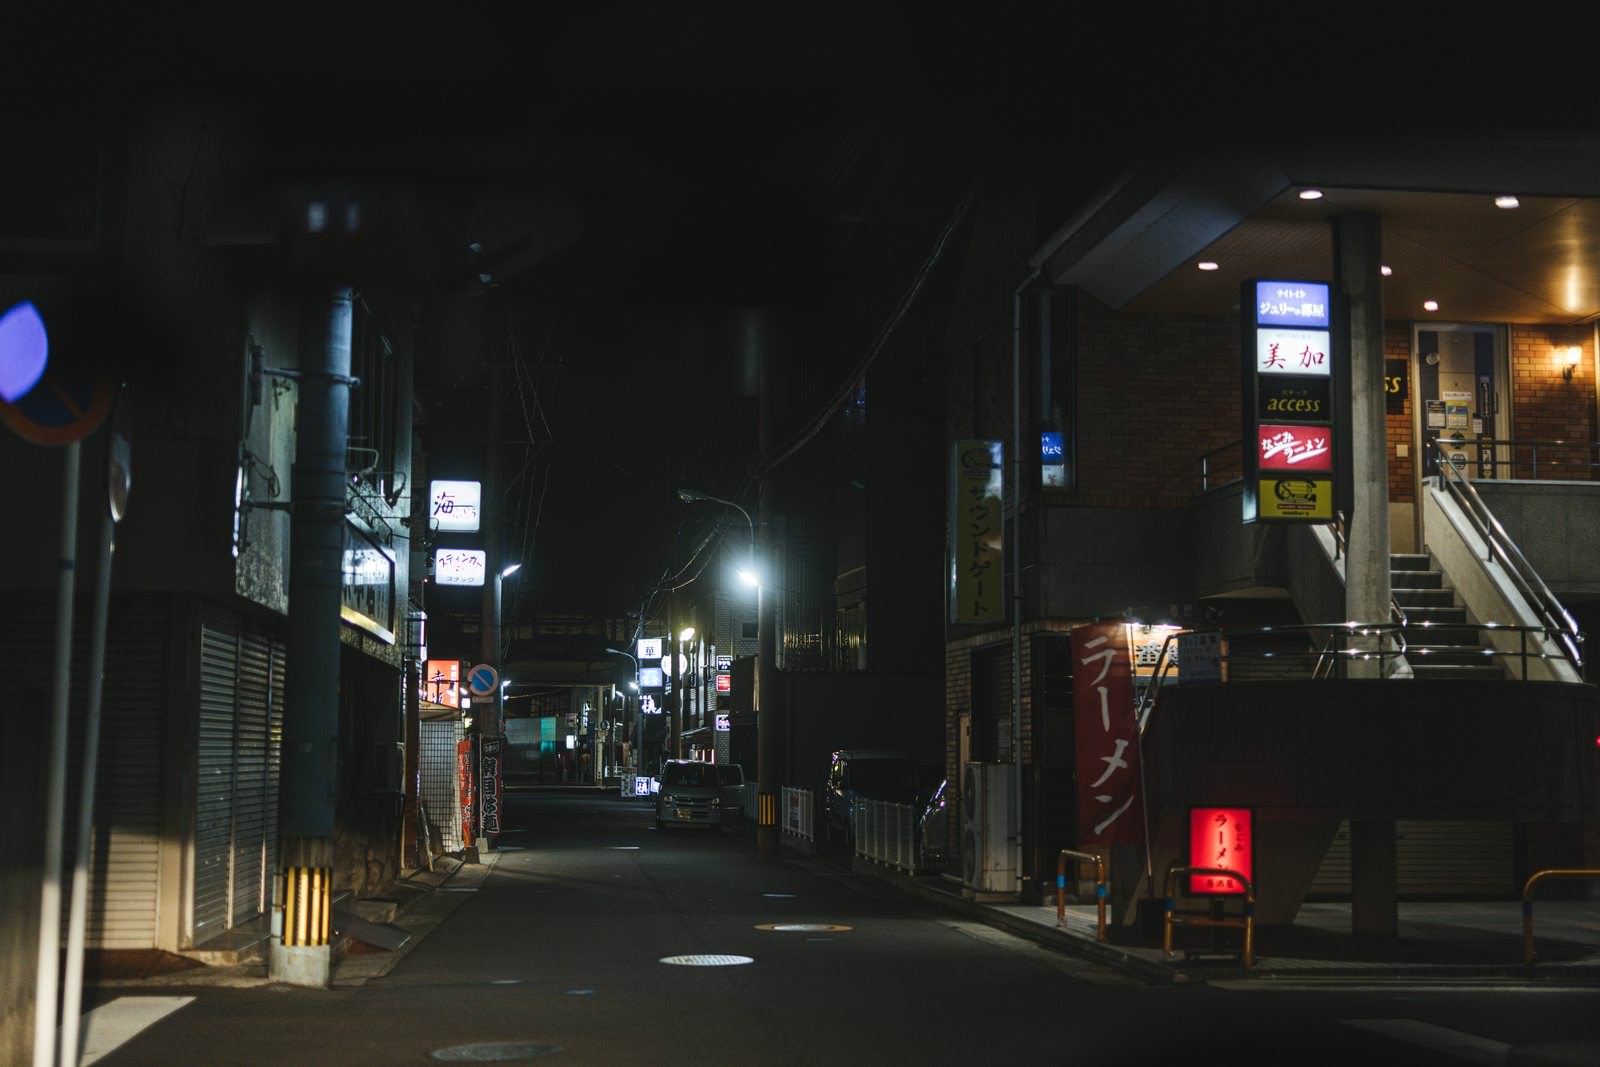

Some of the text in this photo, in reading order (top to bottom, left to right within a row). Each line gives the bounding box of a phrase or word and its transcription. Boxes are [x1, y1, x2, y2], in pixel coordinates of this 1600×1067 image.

[1262, 343, 1325, 369] 美加
[1267, 398, 1321, 412] access
[968, 486, 991, 617] サウンドゲート
[1081, 636, 1134, 835] ラーメン
